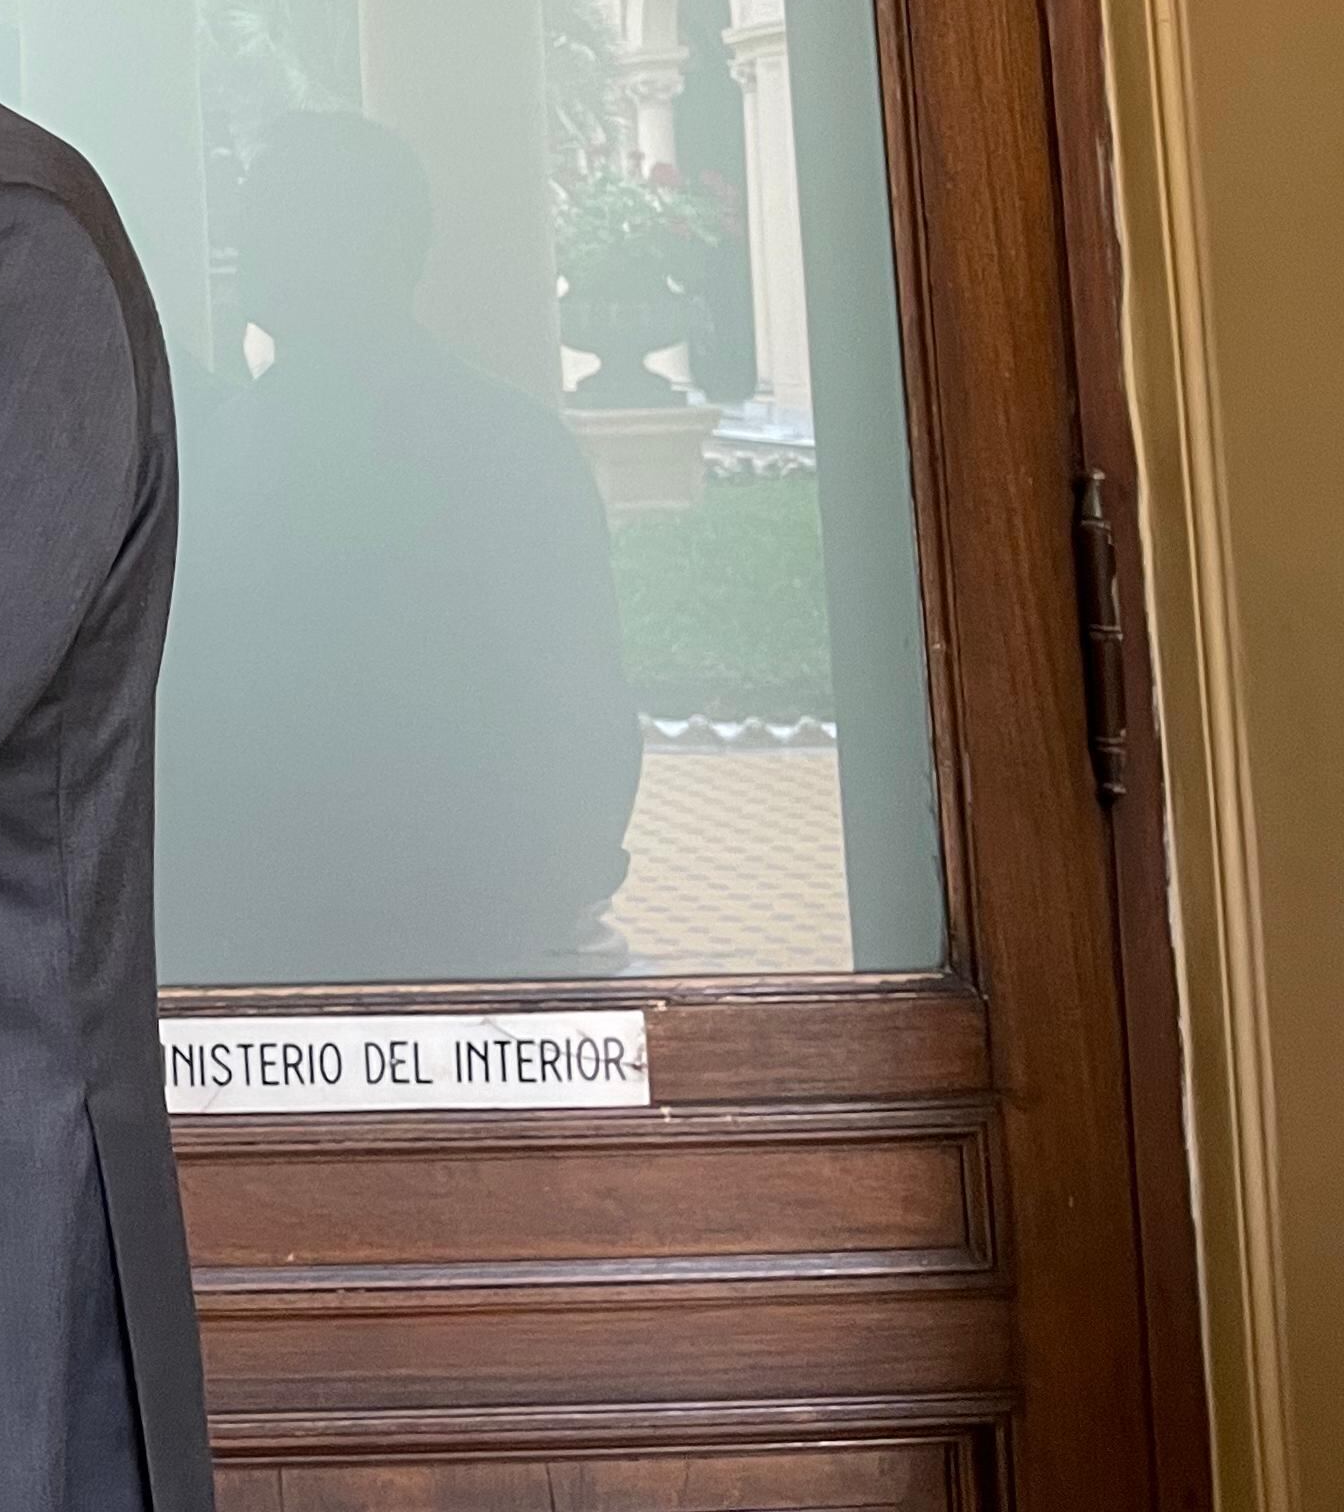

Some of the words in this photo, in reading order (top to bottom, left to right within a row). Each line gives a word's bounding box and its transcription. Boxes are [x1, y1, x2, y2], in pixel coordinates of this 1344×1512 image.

[161, 1042, 343, 1087] NISTERIO
[363, 1041, 433, 1085] DEL
[455, 1038, 626, 1083] INTERIOR
